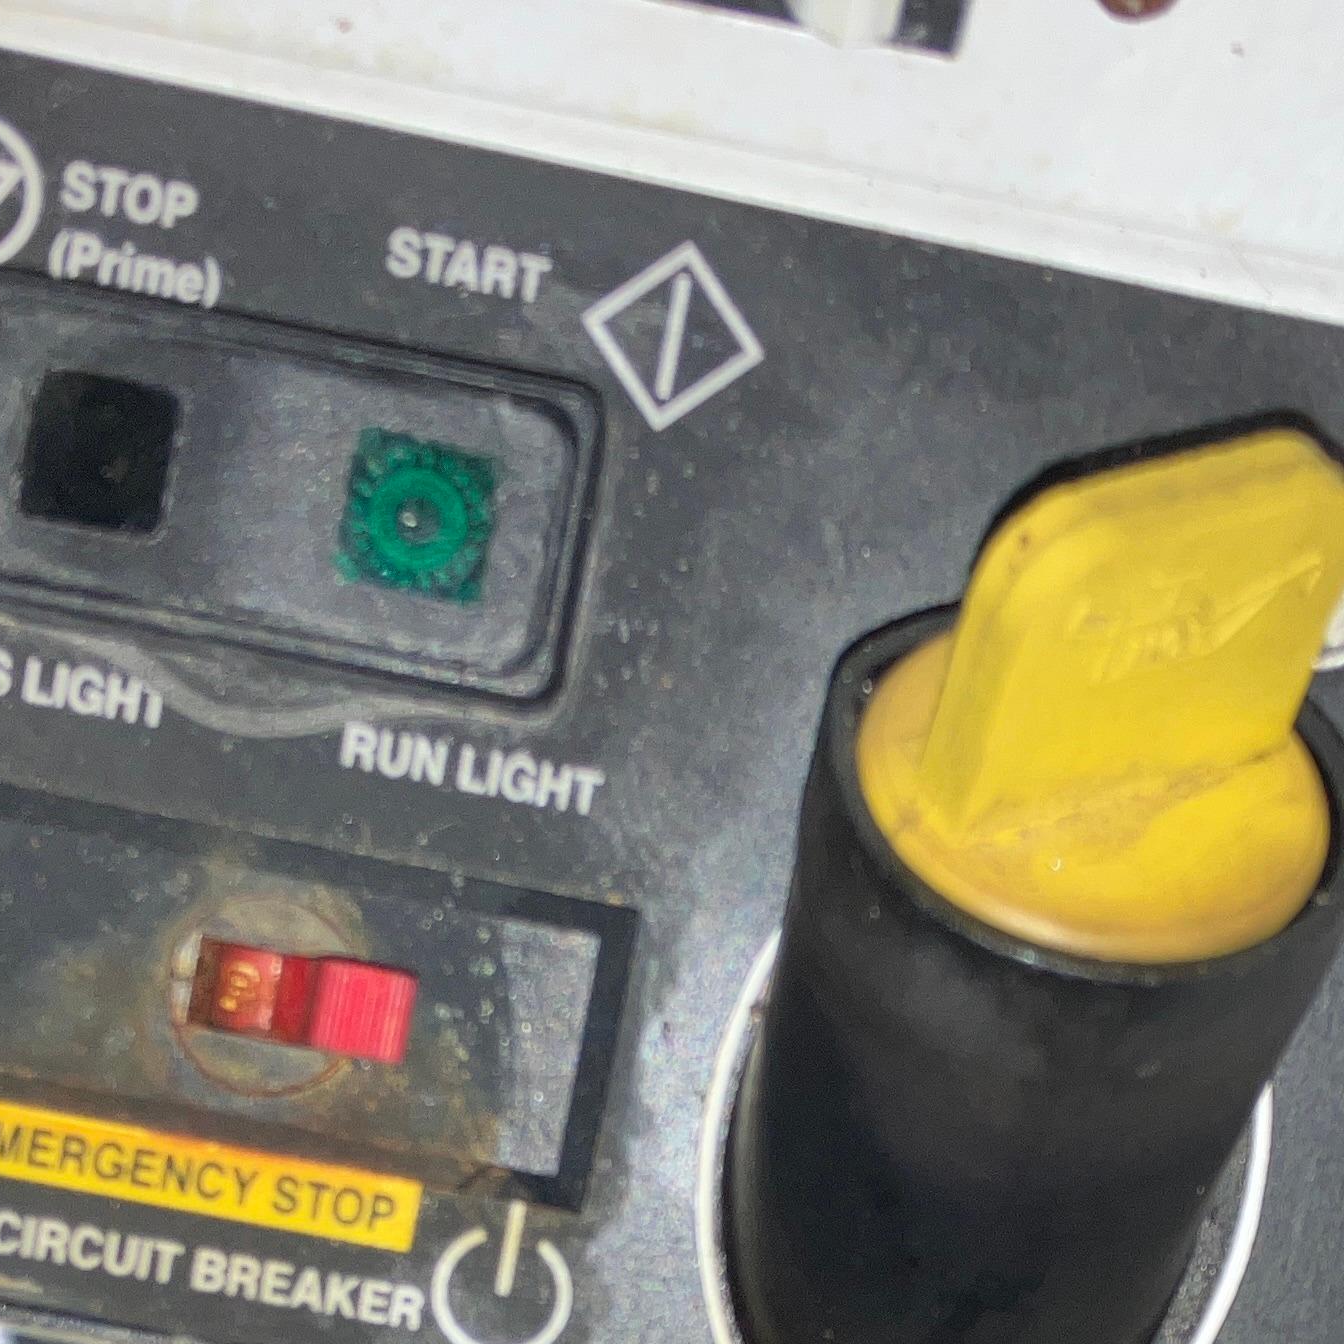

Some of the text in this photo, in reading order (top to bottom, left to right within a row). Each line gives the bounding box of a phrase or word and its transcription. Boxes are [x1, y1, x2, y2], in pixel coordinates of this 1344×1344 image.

[61, 160, 198, 228] STOP
[48, 230, 222, 308] (Prime)
[386, 227, 553, 304] START
[20, 655, 164, 729] LIGHT
[340, 721, 605, 816] RUN LIGHT
[273, 1175, 397, 1234] STOP
[190, 1250, 426, 1331] BREAKER
